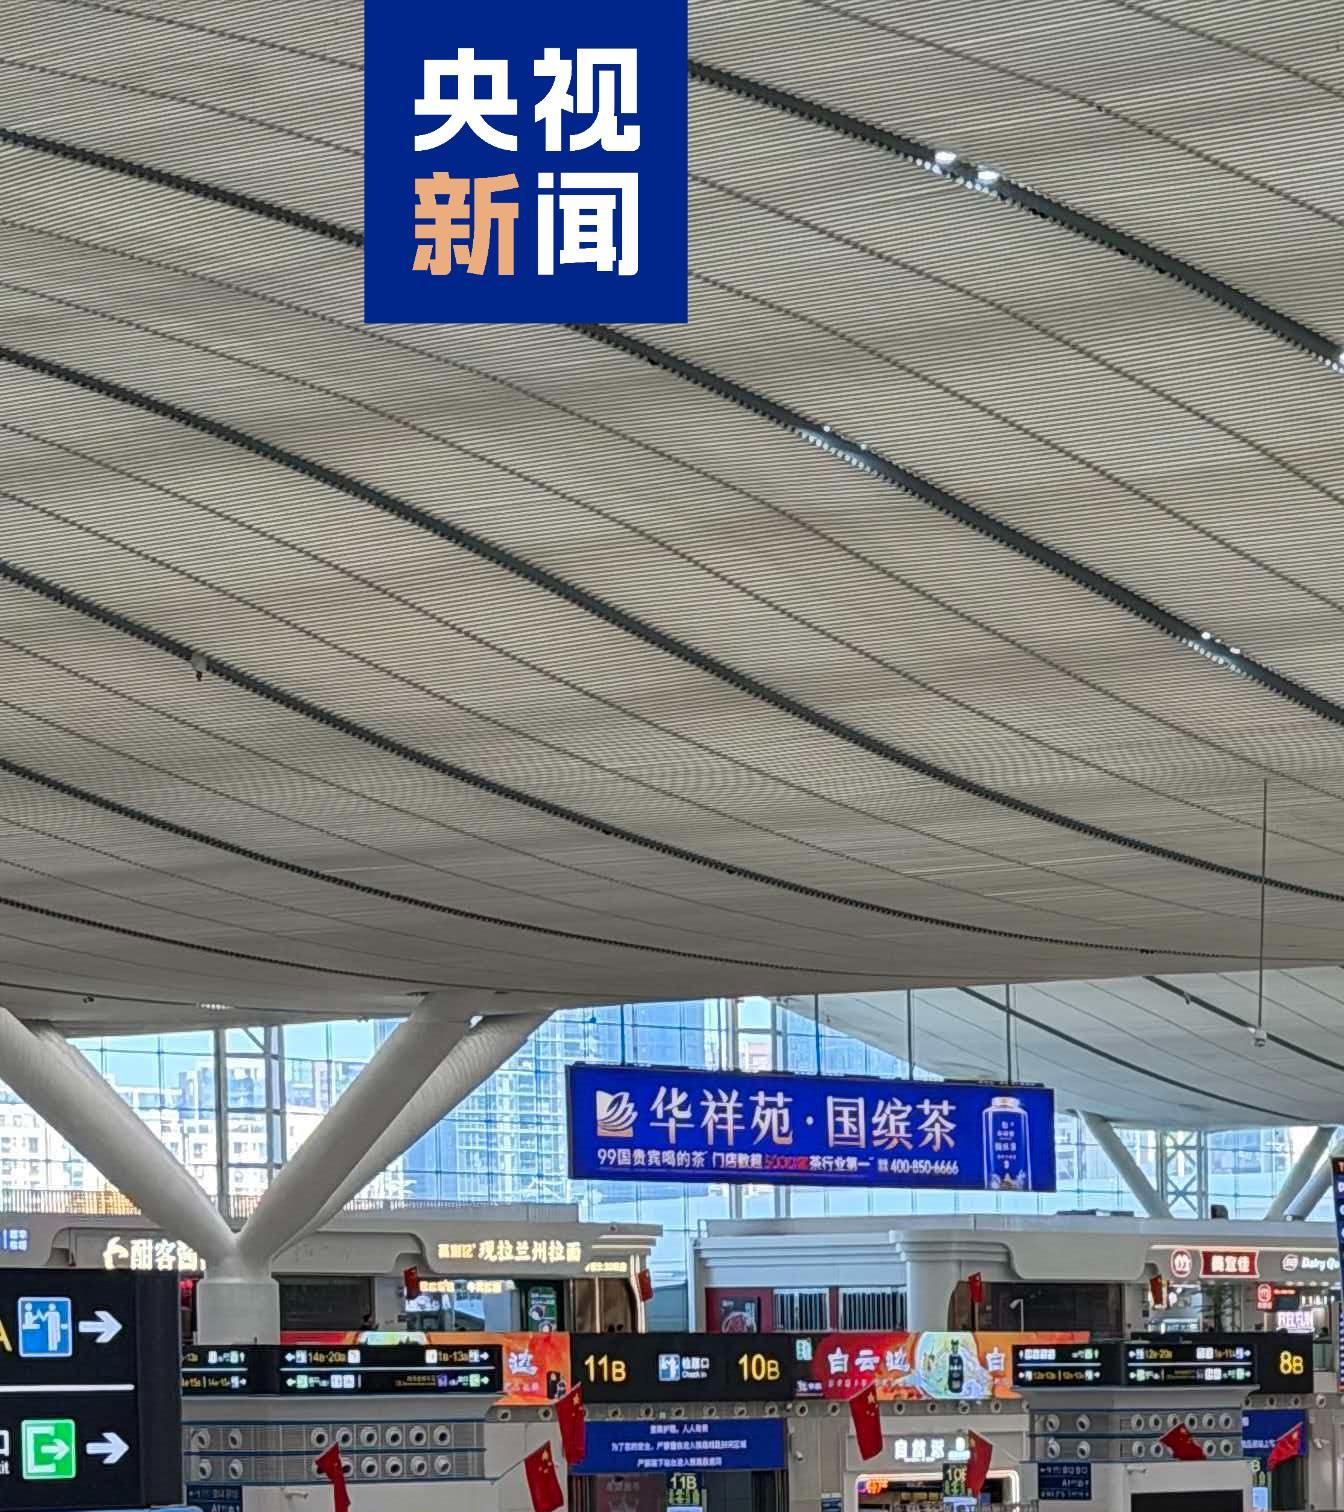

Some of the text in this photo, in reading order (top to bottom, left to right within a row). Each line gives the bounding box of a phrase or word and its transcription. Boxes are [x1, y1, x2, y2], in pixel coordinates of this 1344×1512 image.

[478, 1240, 581, 1263] 现拉兰州拉面
[584, 1353, 627, 1383] 11B
[738, 1353, 780, 1382] 10B
[985, 1347, 1005, 1372] 白
[1280, 1350, 1304, 1375] 8B
[669, 1474, 697, 1491] 11B
